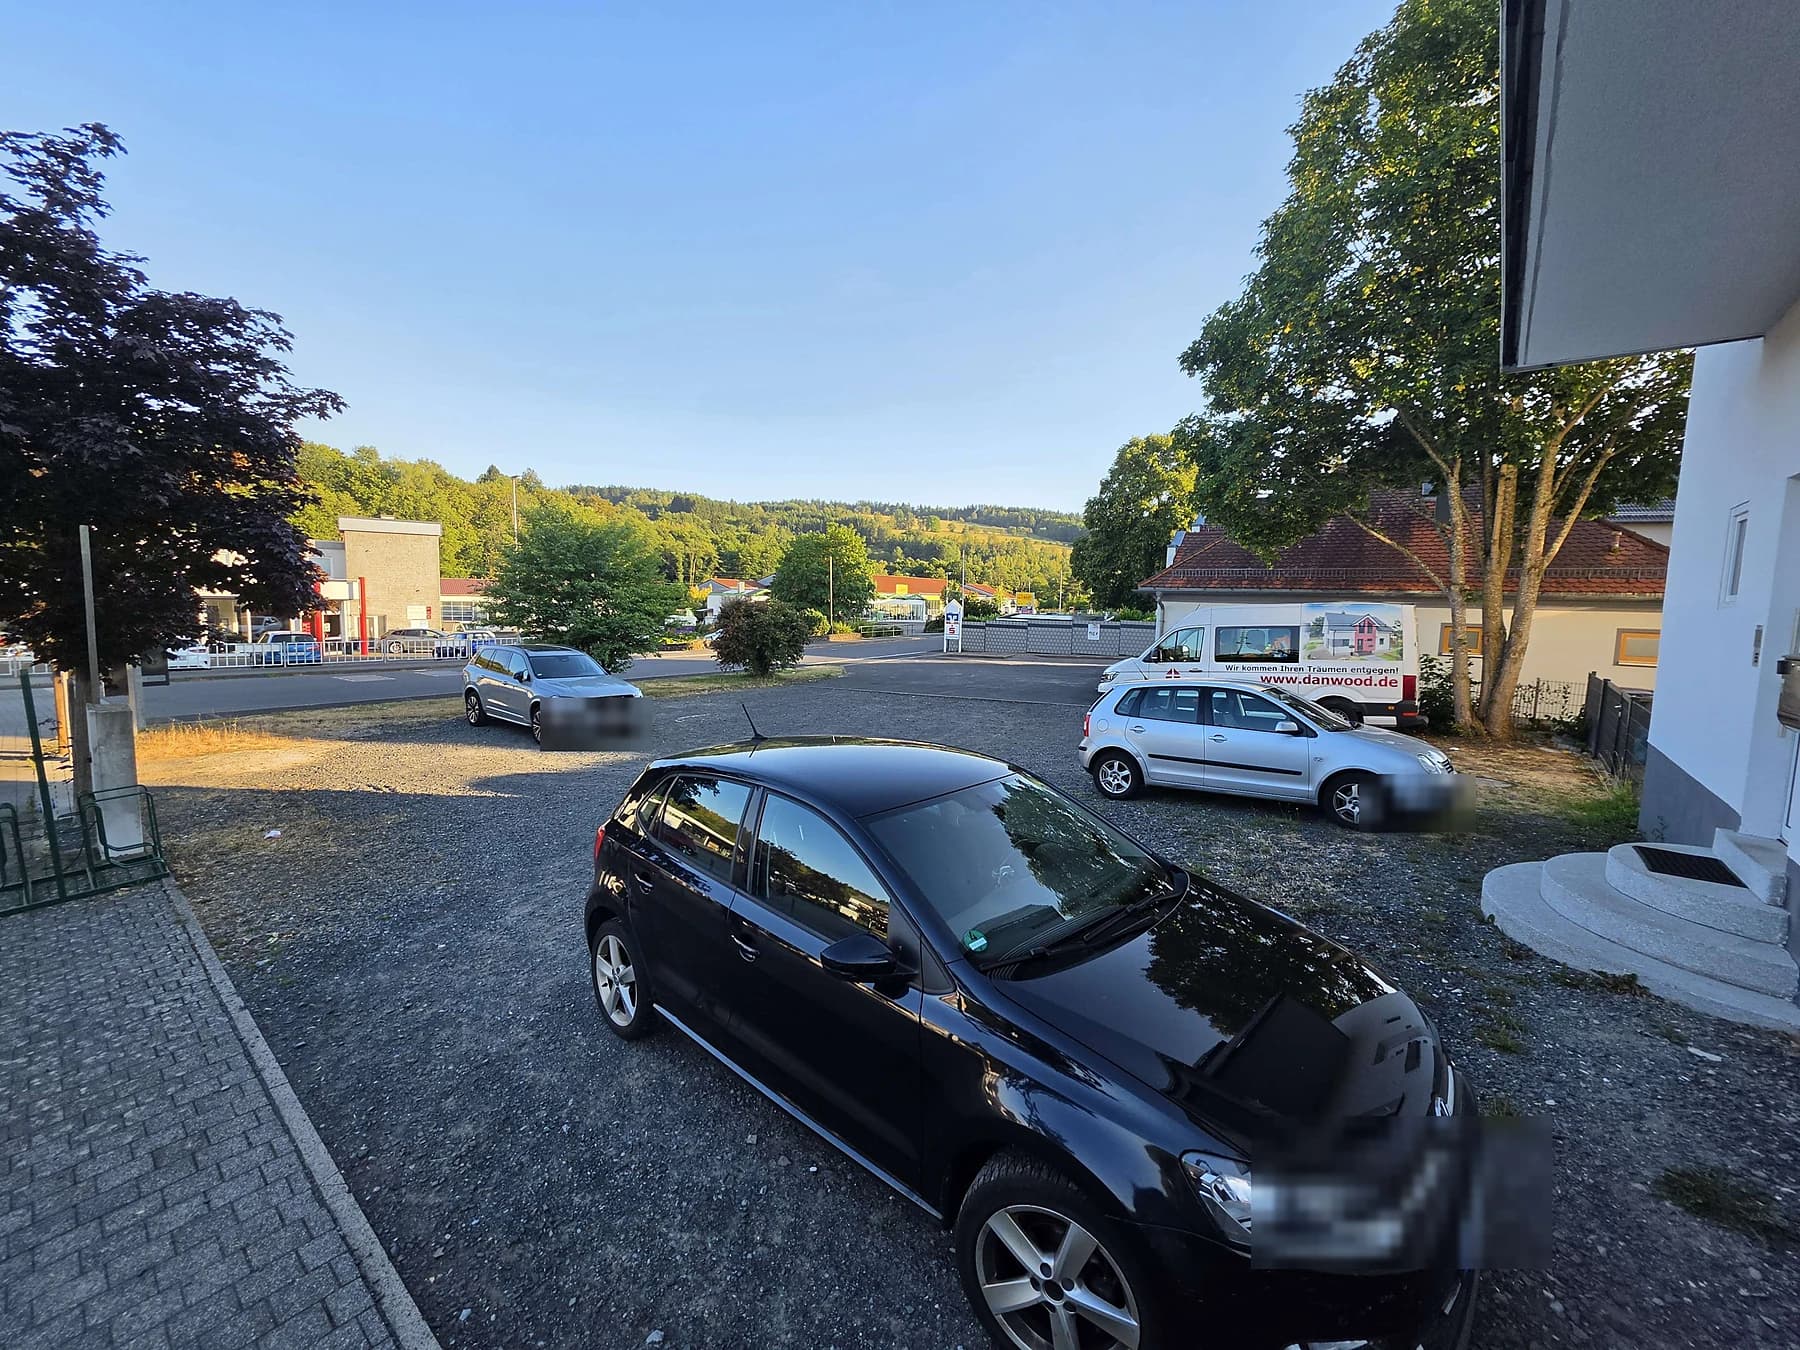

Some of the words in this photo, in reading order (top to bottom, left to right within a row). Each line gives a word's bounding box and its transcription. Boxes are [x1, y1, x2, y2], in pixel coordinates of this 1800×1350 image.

[1225, 664, 1239, 672] Wir
[1242, 664, 1278, 672] kommen
[1280, 665, 1305, 673] Ihren
[1307, 665, 1348, 673] Träumen
[1350, 666, 1399, 676] entgegen!
[1260, 675, 1399, 688] www.danwood.de
